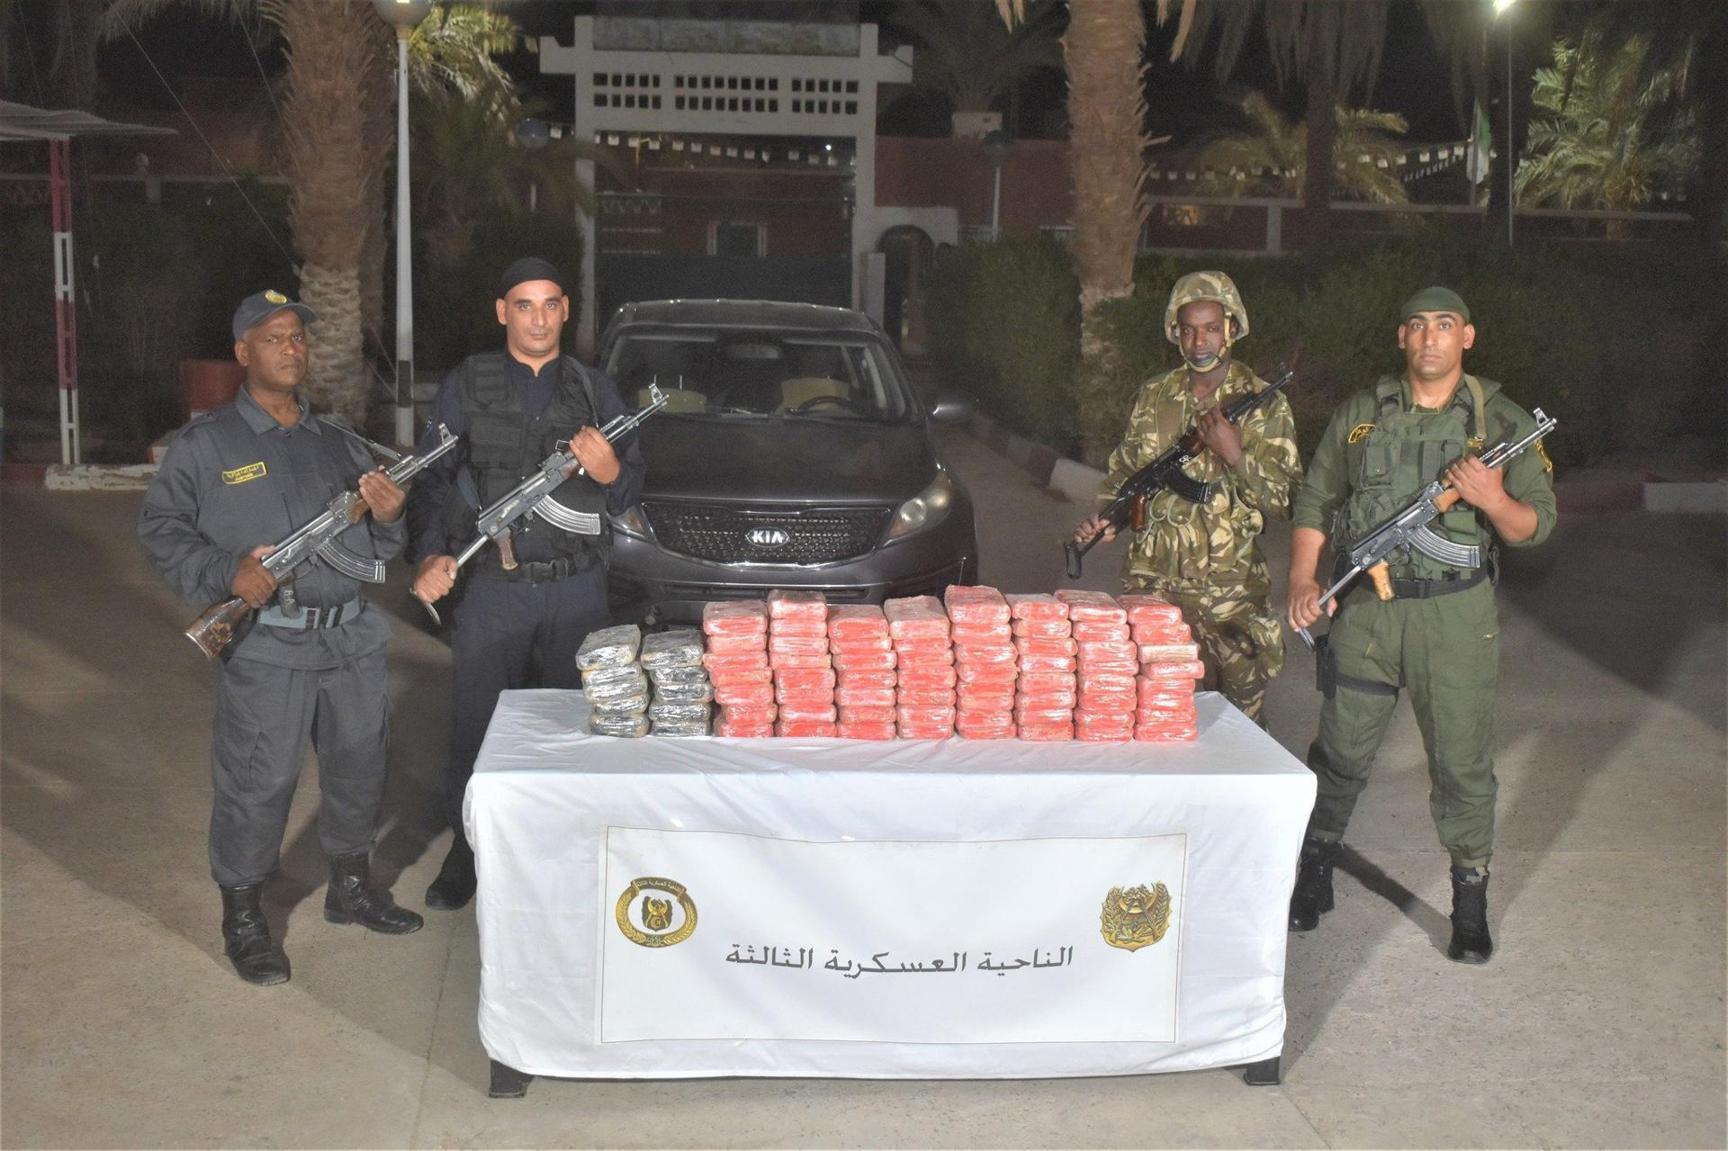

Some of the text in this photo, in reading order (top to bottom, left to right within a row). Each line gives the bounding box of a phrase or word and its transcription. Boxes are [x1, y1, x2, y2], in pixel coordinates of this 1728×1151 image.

[752, 530, 784, 543] KIA
[725, 943, 1074, 980] الناحية العسكرية الثالثة
